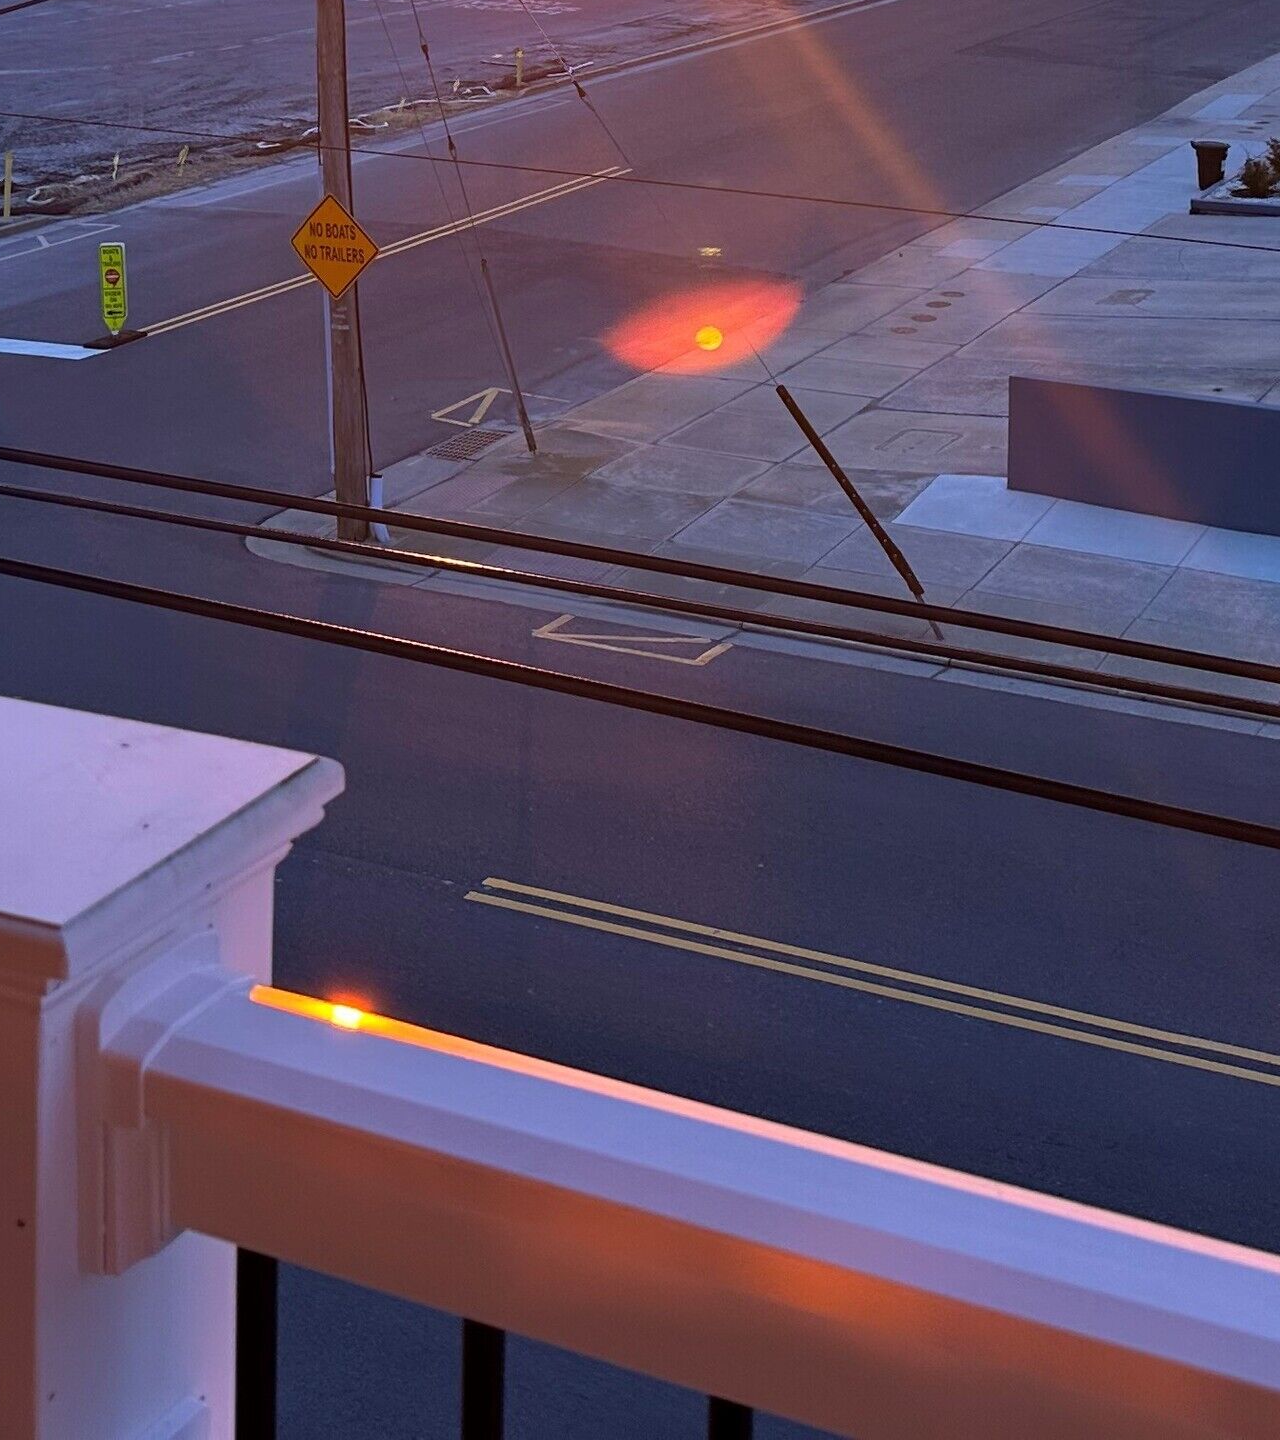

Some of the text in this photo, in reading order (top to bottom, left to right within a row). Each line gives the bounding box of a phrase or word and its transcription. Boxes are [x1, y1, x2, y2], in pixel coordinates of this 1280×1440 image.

[309, 222, 357, 240] NO BOATS
[304, 244, 365, 264] NO TRAILERS
